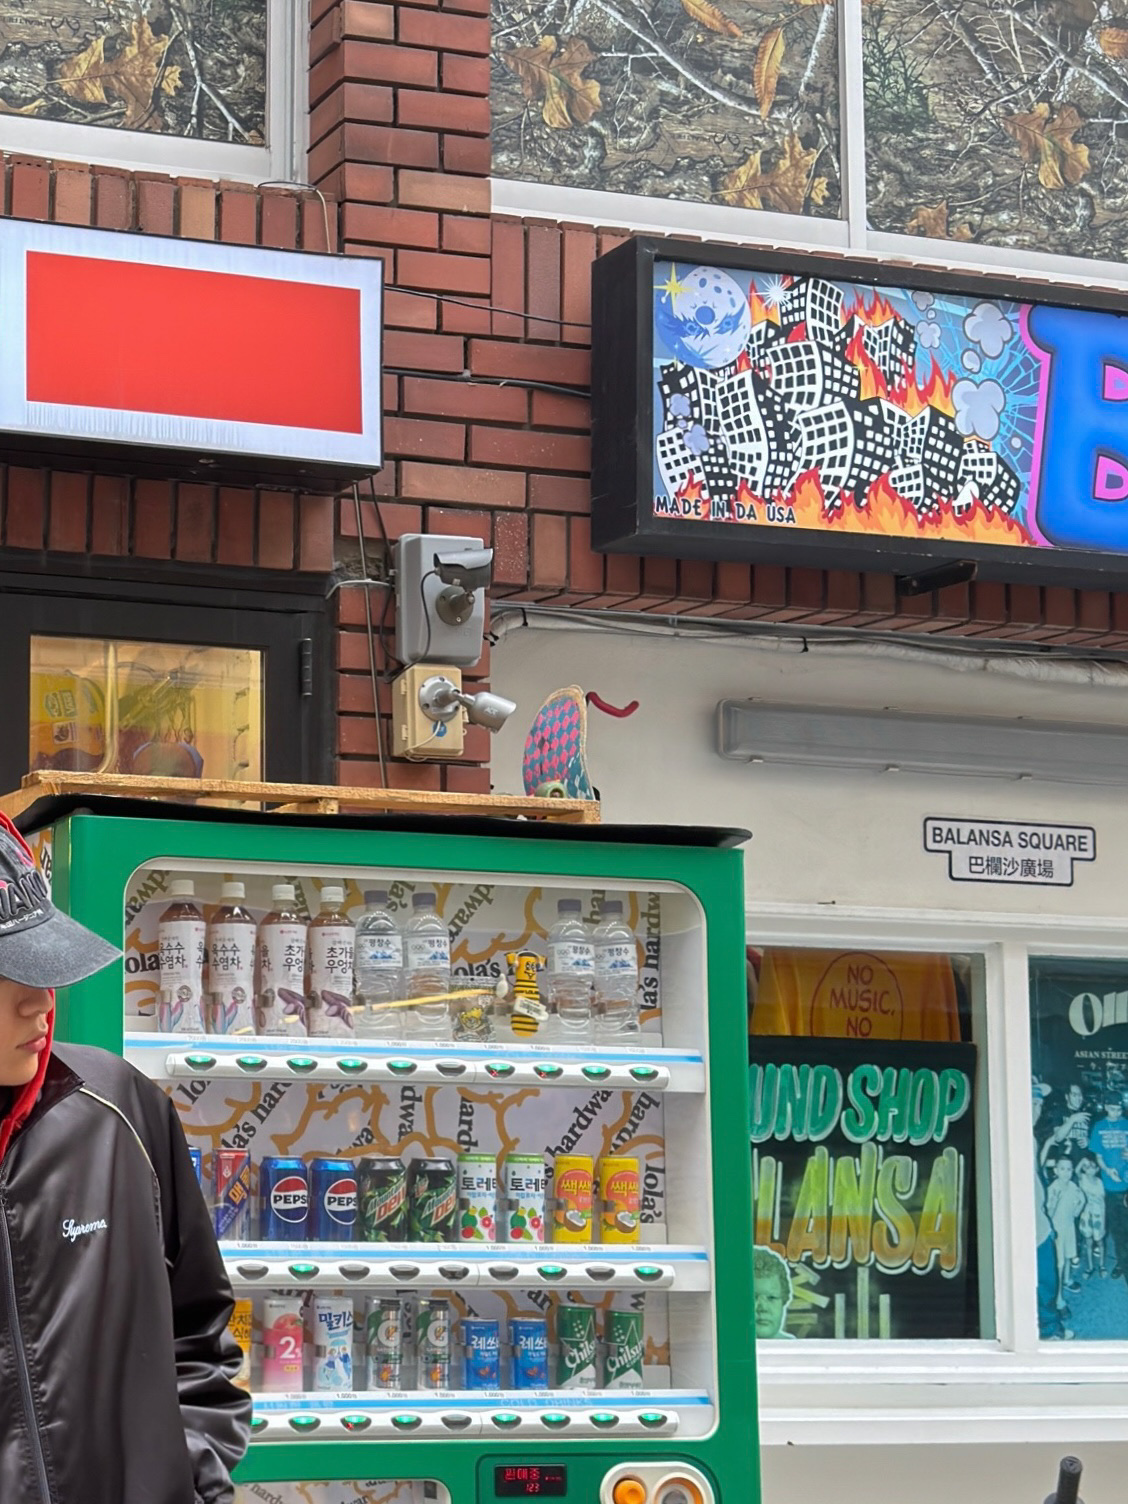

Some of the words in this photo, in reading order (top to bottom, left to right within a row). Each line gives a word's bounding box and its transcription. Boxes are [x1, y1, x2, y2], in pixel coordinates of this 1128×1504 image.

[655, 498, 702, 519] MADE
[711, 501, 729, 519] IN
[736, 501, 759, 522] DA
[767, 503, 796, 525] USA
[932, 827, 1013, 848] BALANSA
[1018, 832, 1089, 852] SQUARE
[969, 856, 1054, 878] 巴欄沙廣場
[212, 943, 240, 956] 옥수수
[284, 945, 304, 956] 초가
[126, 952, 160, 974] ola
[212, 956, 240, 971] 수염차
[283, 958, 303, 973] 우엉
[454, 958, 501, 981] ola's
[847, 964, 873, 984] NO
[830, 988, 895, 1016] MUSIC,
[846, 1017, 872, 1038] NO
[1074, 1050, 1100, 1058] ASIAN
[748, 1063, 843, 1142] UND
[841, 1063, 971, 1145] SHOP
[273, 1195, 307, 1204] PEPS
[327, 1196, 358, 1207] PEPS
[755, 1141, 964, 1279] LANSA
[565, 1340, 596, 1369] Chils
[525, 1483, 540, 1492] 123
